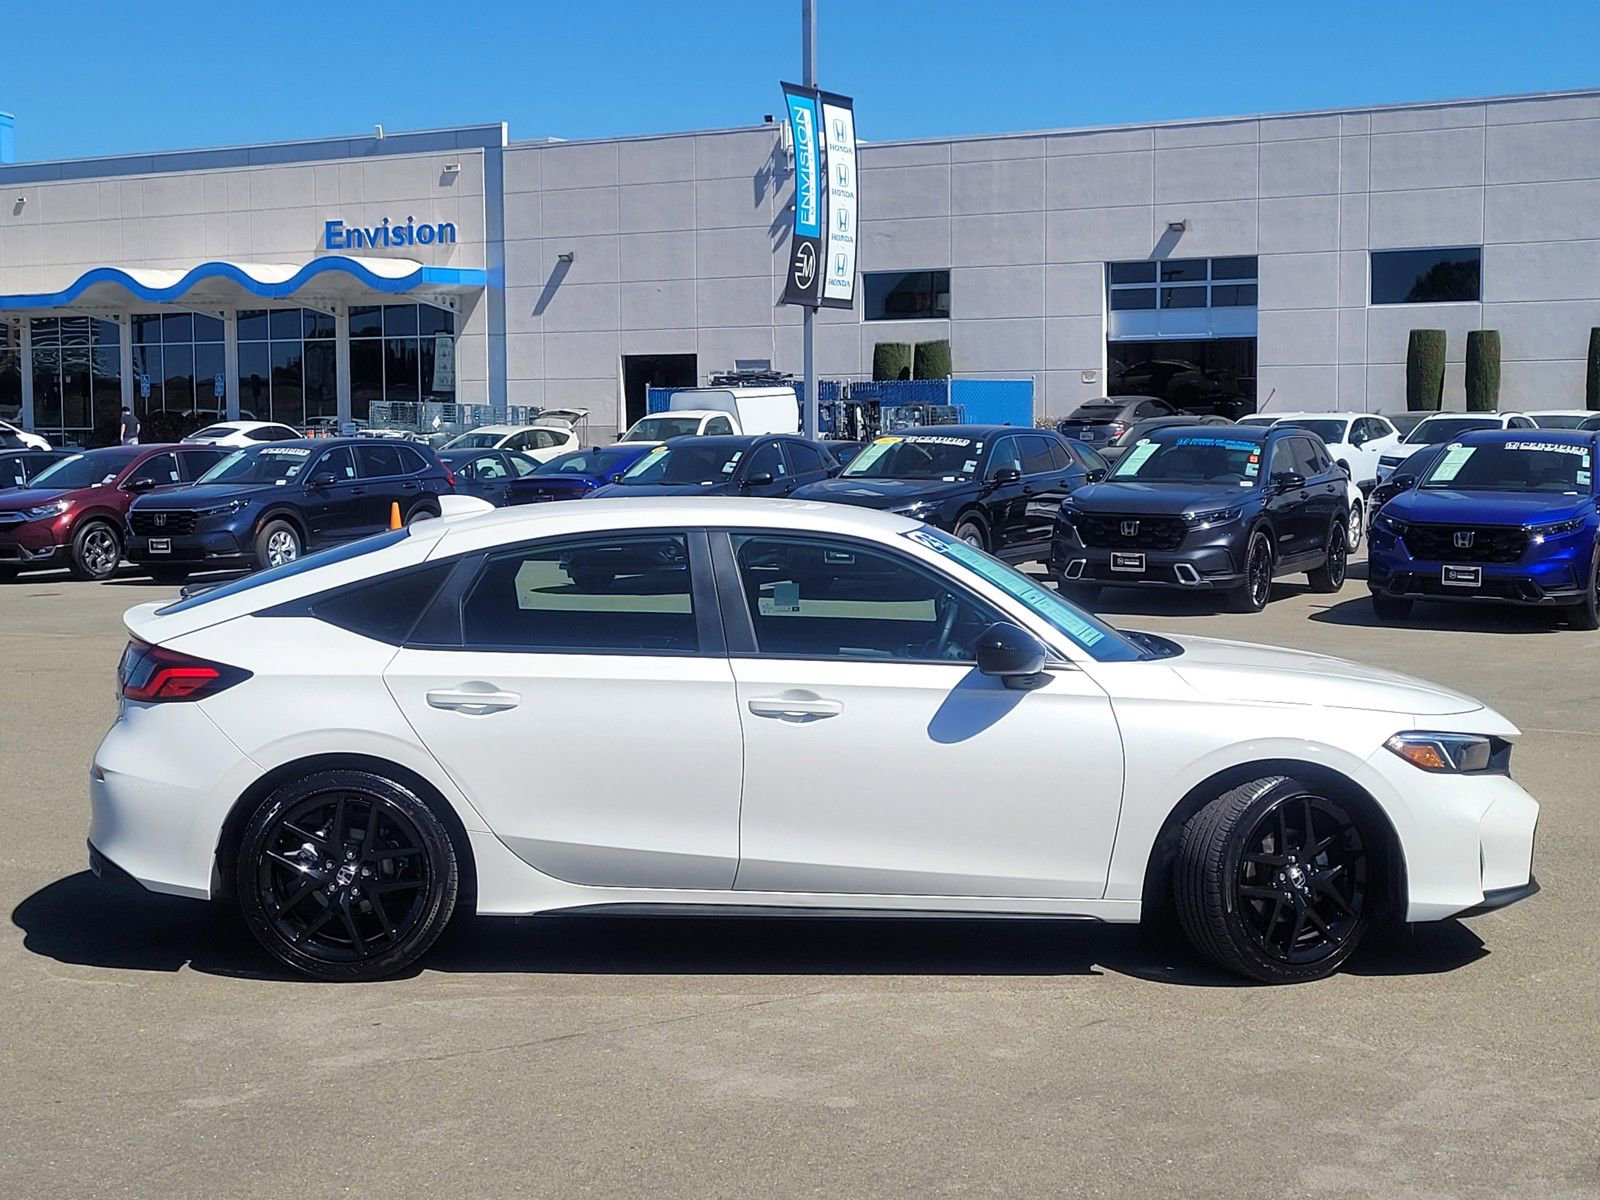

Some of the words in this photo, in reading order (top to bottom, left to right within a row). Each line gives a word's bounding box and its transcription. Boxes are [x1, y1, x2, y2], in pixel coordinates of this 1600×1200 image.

[829, 143, 853, 155] HONDA
[794, 106, 813, 226] ENVISION
[831, 187, 855, 199] HONDA
[325, 215, 456, 249] Envision
[831, 233, 854, 244] HONDA
[828, 278, 851, 288] HONDA
[1519, 442, 1588, 456] CERTIFIED
